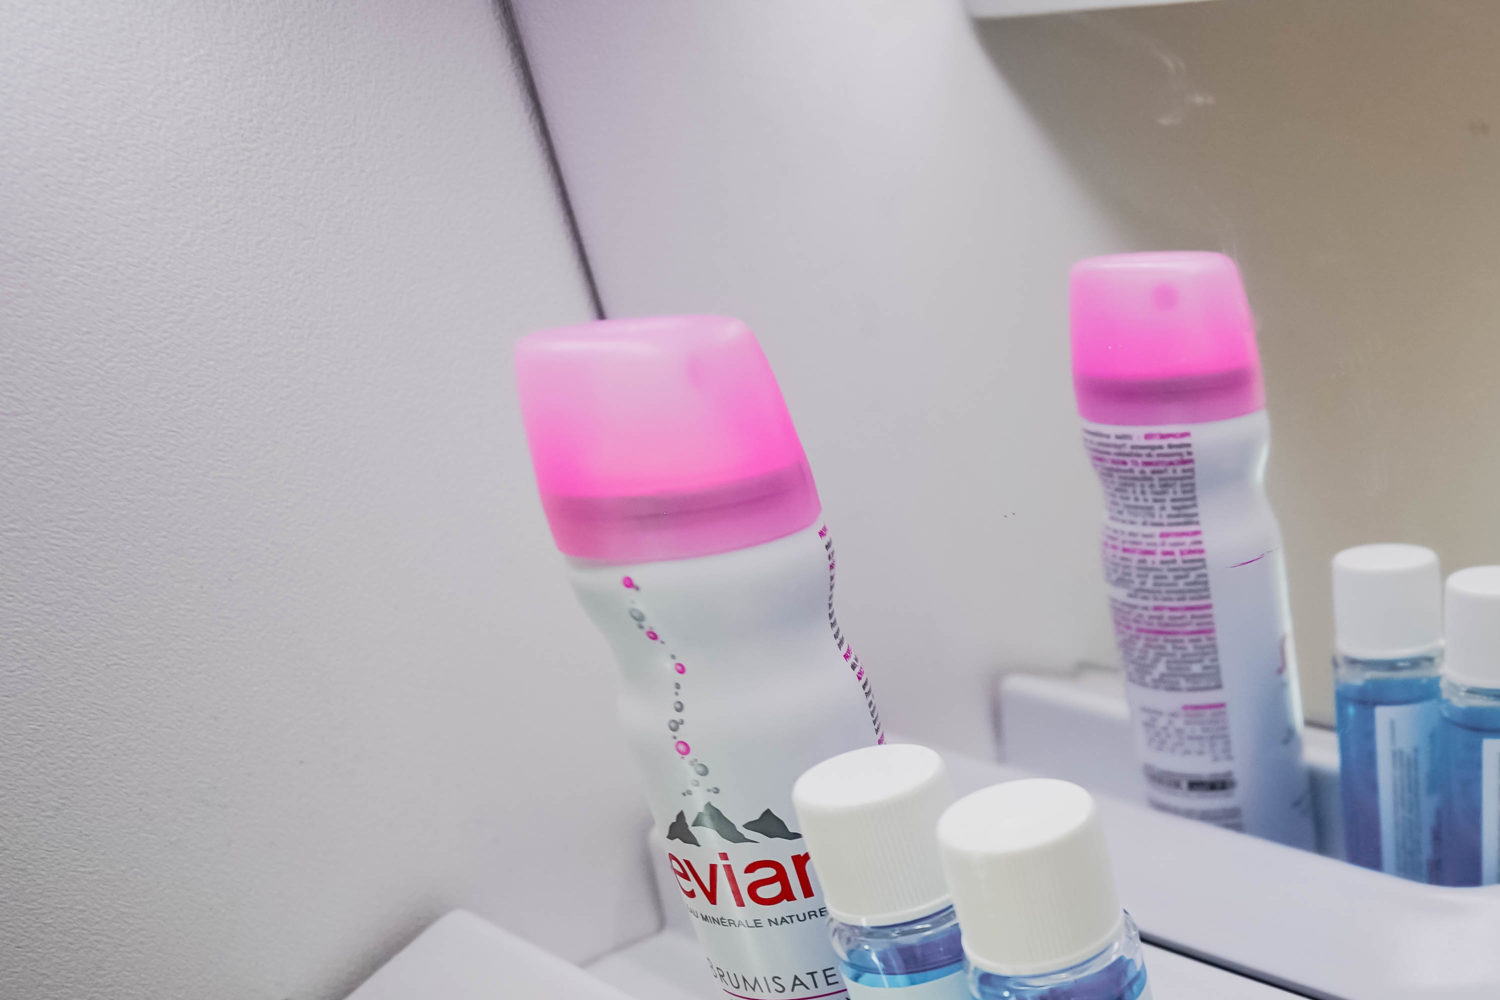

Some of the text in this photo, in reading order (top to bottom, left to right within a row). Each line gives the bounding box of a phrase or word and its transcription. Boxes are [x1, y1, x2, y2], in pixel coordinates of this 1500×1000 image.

[700, 912, 763, 928] MINÉRALE
[768, 907, 827, 927] NATURE
[706, 957, 839, 993] BRUMISATE
